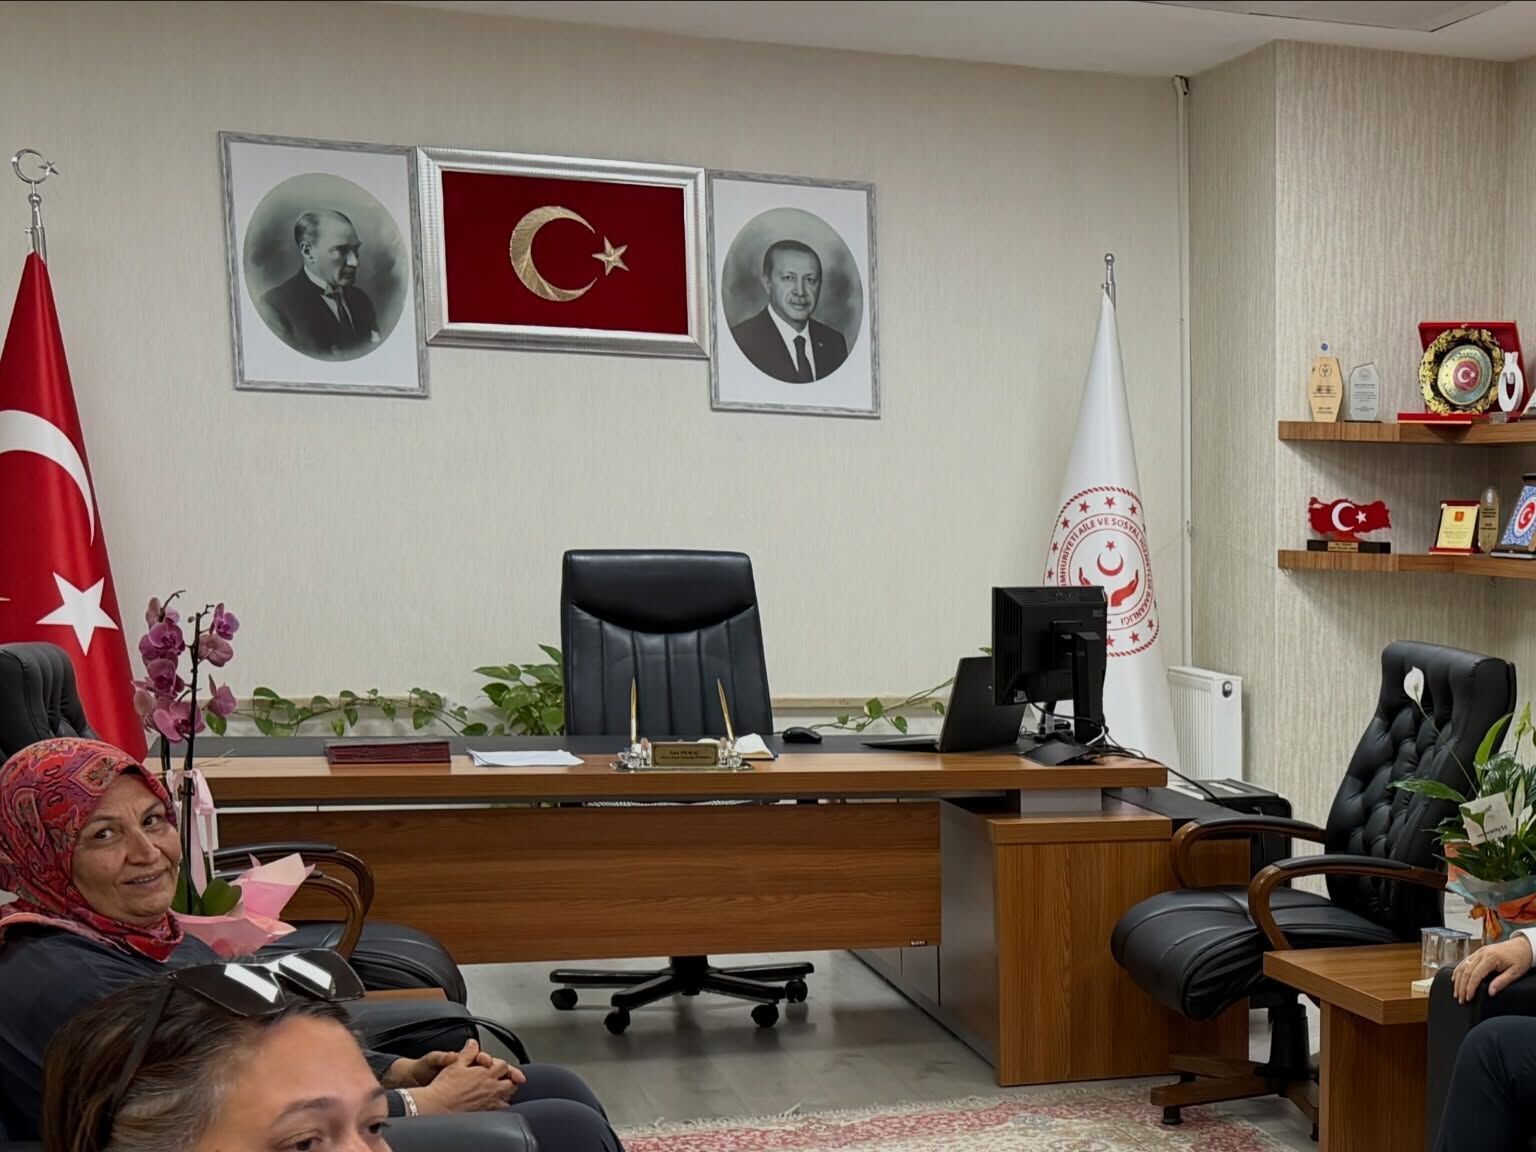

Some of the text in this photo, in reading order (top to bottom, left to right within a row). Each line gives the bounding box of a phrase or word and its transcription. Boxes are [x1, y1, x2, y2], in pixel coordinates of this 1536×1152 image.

[1060, 531, 1079, 586] MHURİYETİ
[1079, 520, 1097, 535] AİLE
[1097, 517, 1110, 526] VE
[1112, 517, 1140, 540] SOSYAL
